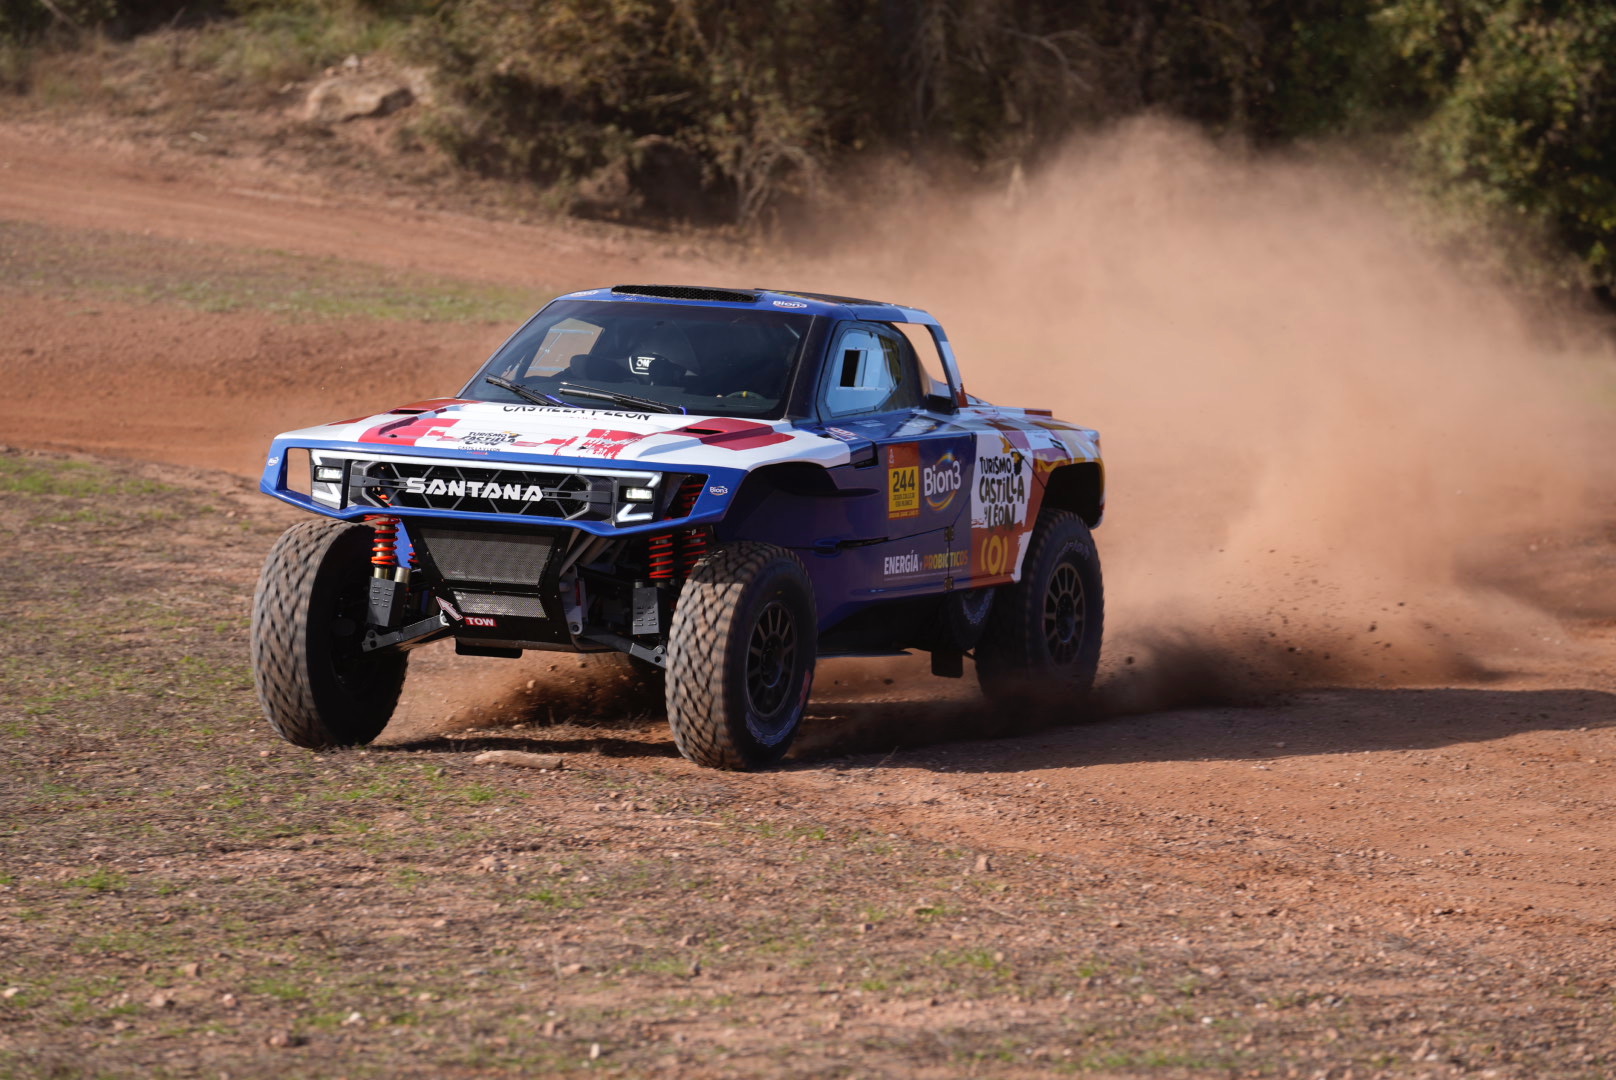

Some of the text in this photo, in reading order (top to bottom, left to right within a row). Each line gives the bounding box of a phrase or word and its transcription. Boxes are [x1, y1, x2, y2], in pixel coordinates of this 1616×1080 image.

[405, 477, 544, 502] SANTANA
[893, 469, 915, 493] 244
[923, 460, 962, 497] Bion3
[883, 549, 919, 575] ENERGÍA
[923, 547, 969, 570] PROBIÓTICOS
[465, 617, 494, 626] TOW
